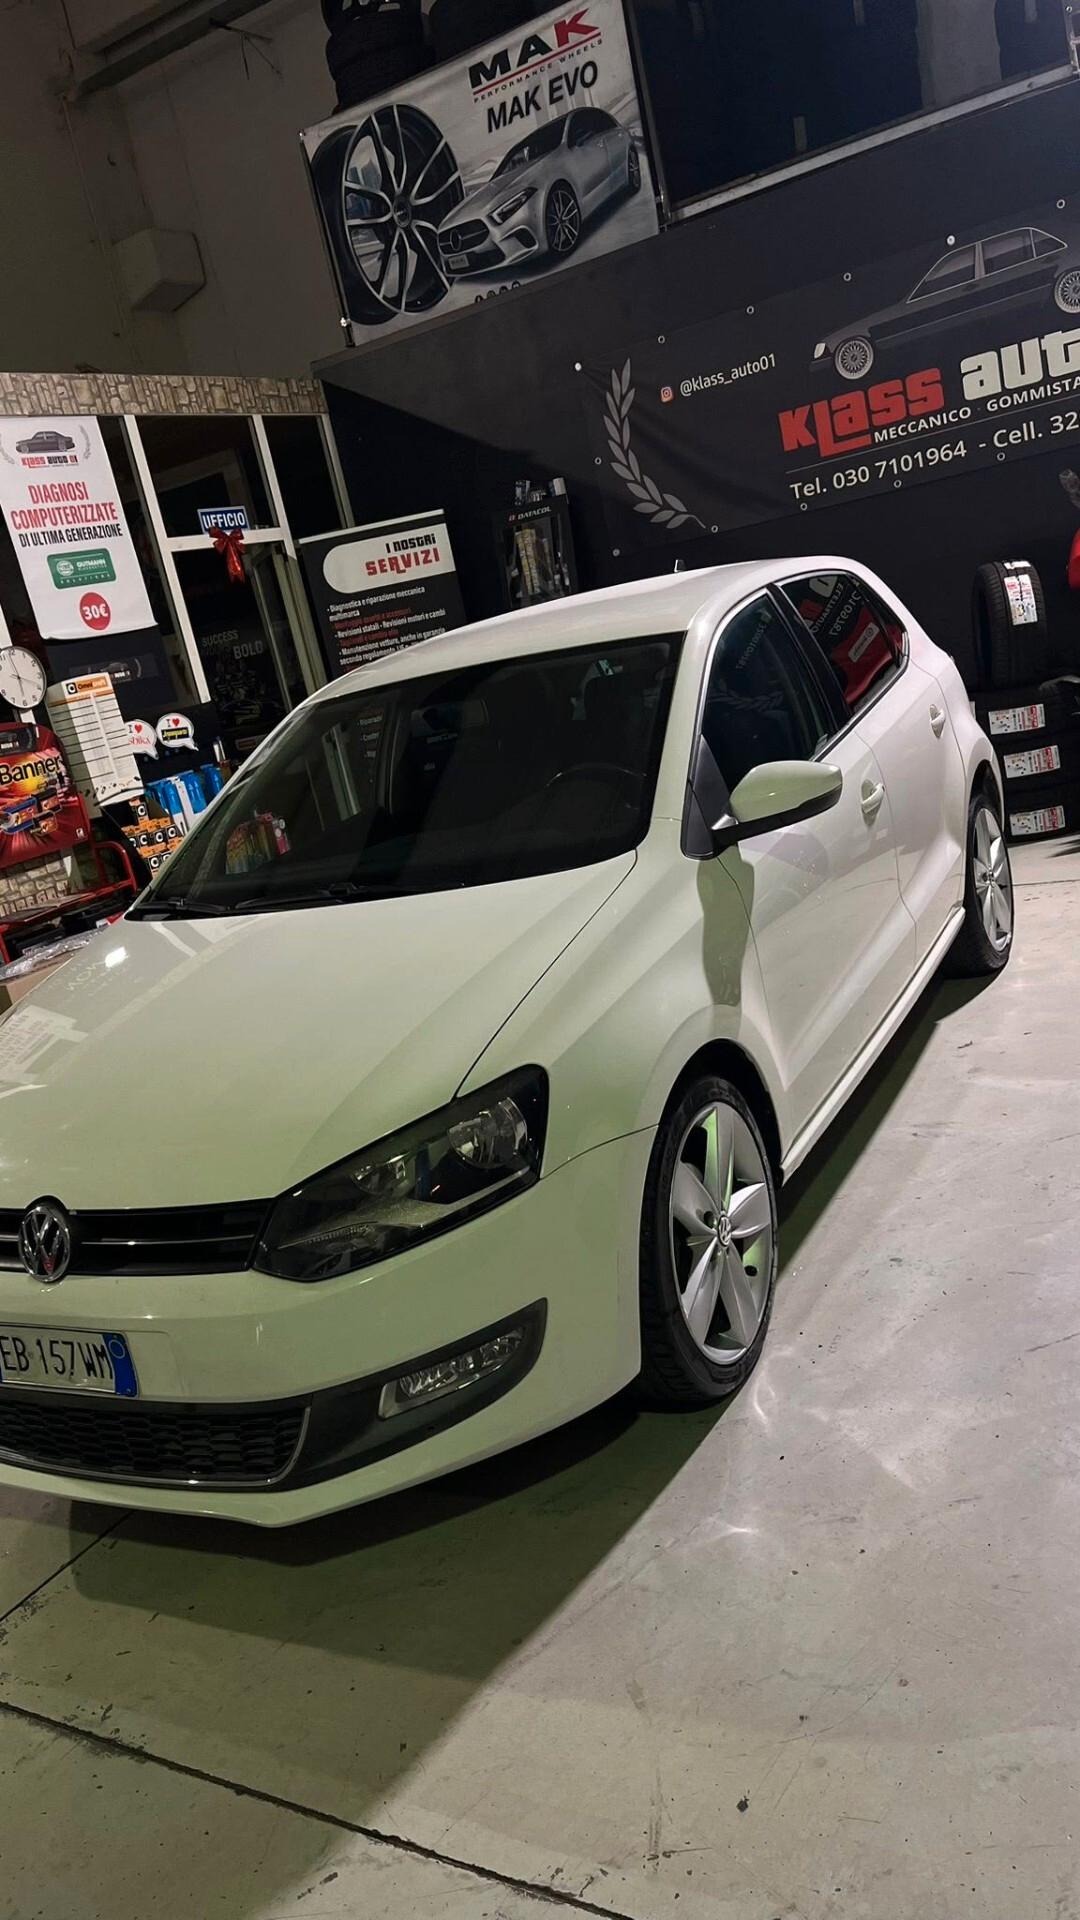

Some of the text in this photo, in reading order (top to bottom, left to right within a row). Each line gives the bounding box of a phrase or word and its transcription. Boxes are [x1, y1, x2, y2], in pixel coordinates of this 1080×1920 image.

[468, 8, 599, 89] MAK
[474, 39, 602, 103] PERFORMANCE WHEELS
[487, 60, 598, 133] MAK EVO
[680, 353, 776, 396] @klass_auto01
[874, 406, 971, 443] MECCANICO
[790, 477, 827, 500] Tel.
[832, 465, 870, 490] 030
[875, 440, 967, 479] 7101964
[993, 421, 1043, 448] Cell.
[28, 481, 89, 504] DIAGNOSI
[10, 502, 118, 531] COMPUTERIZZATE
[202, 512, 246, 529] UFFICIO
[518, 506, 552, 520] DATACOL
[18, 523, 123, 547] DI ULTIMA GENERAZIONE
[365, 547, 440, 576] SERVIZI
[82, 603, 109, 620] 30€
[329, 600, 361, 612] Diagnostica
[366, 592, 396, 606] riparazione
[396, 586, 425, 598] meccanica
[429, 608, 446, 618] cambi
[202, 630, 239, 647] SUCCESS
[233, 640, 264, 659] BOLD
[400, 633, 416, 643] anche
[0, 755, 60, 786] Banner
